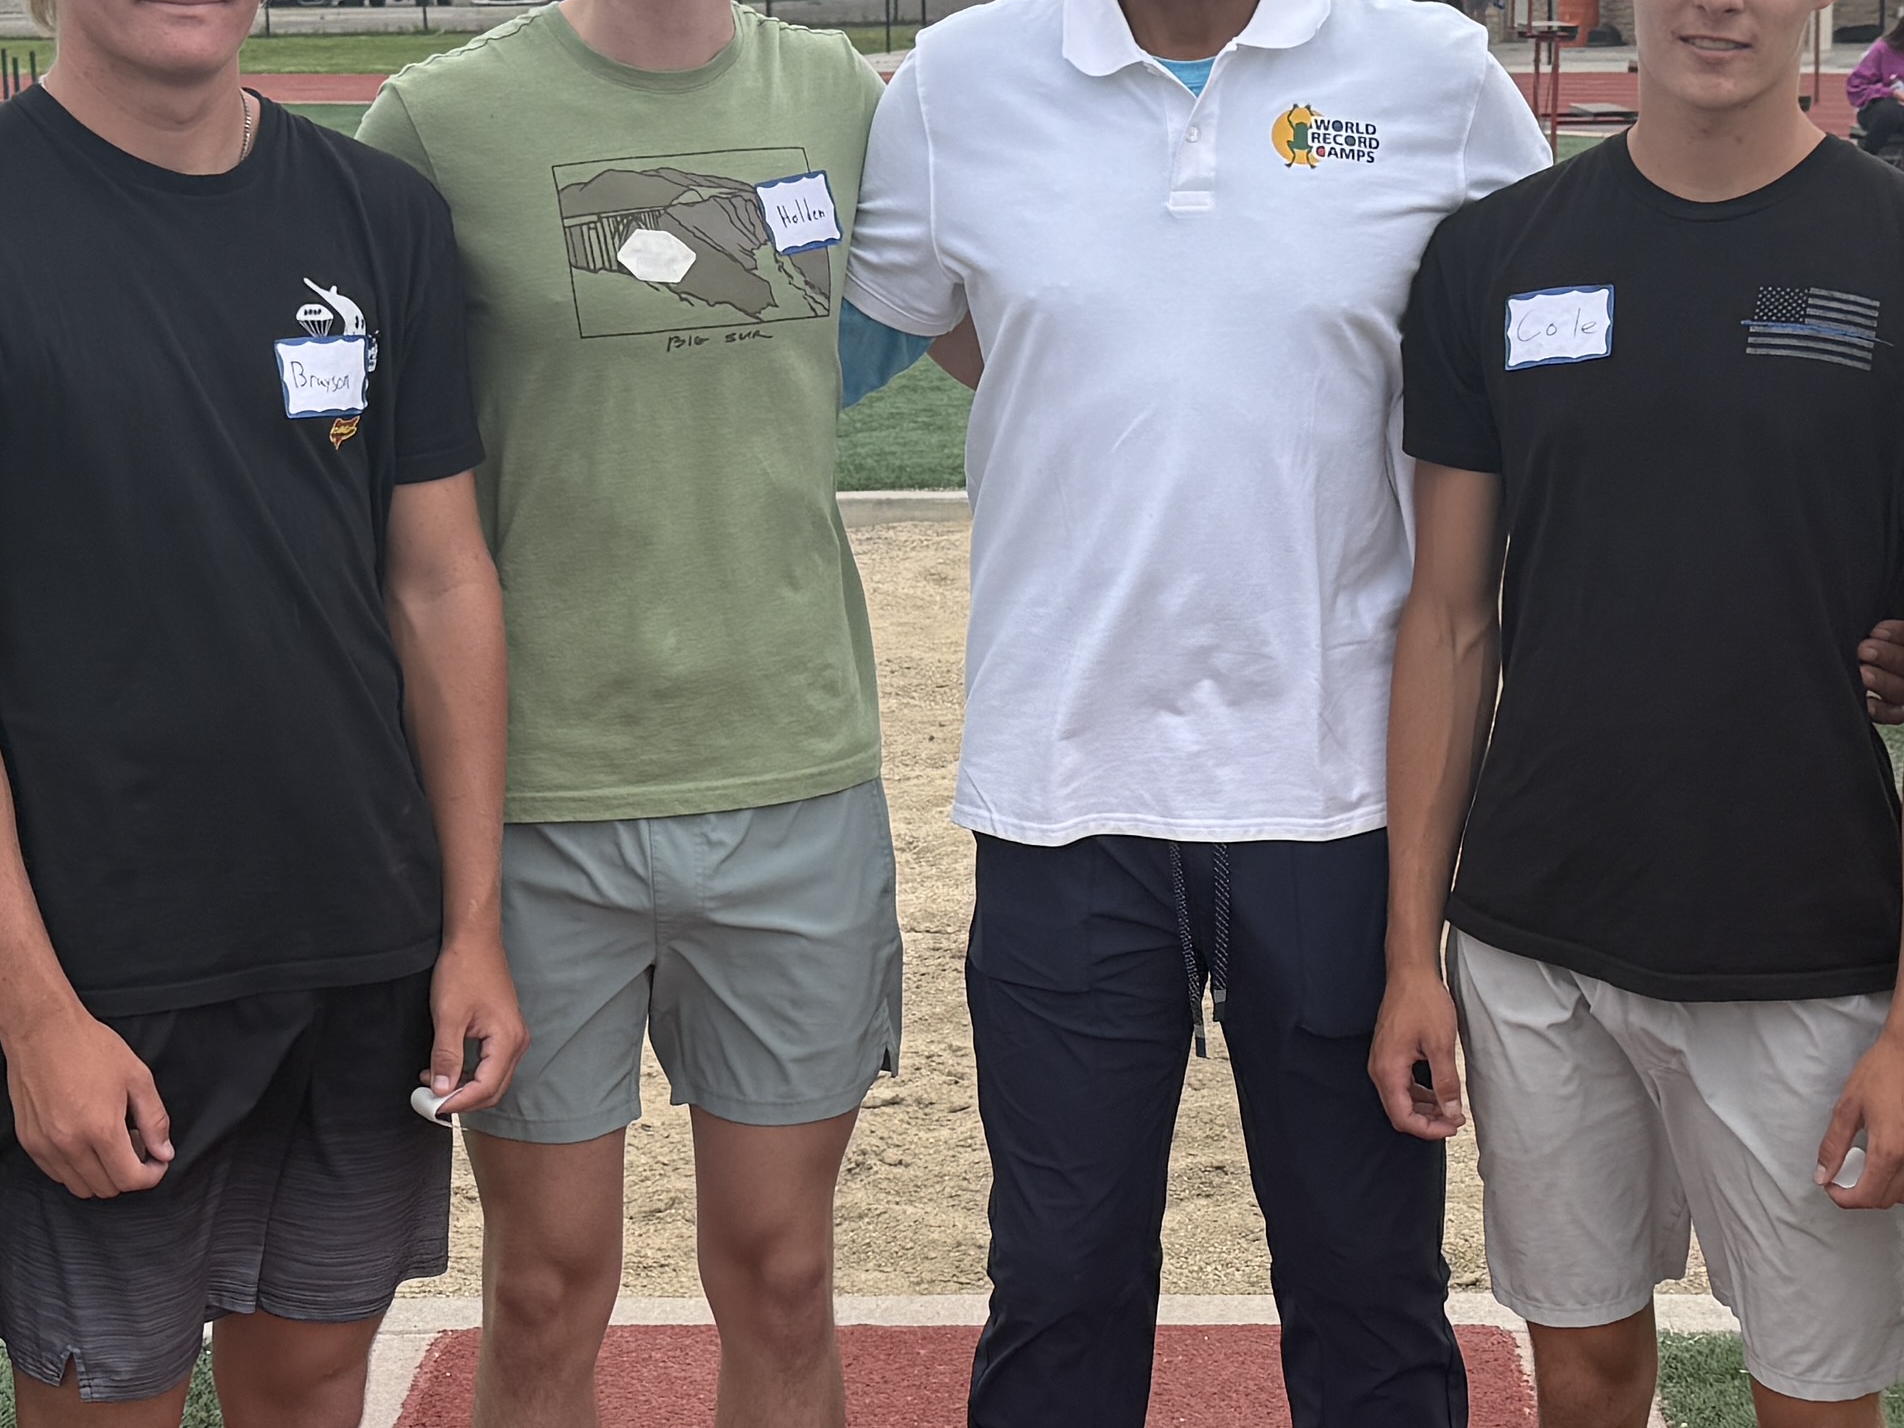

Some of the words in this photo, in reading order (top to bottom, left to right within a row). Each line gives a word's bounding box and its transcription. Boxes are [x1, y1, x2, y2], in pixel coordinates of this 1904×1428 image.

[1313, 118, 1377, 136] WORLD
[1310, 131, 1381, 151] RECORD
[1315, 145, 1376, 164] CAMPS
[776, 197, 826, 229] Holden
[1516, 307, 1598, 342] Cole
[666, 334, 710, 353] BIG
[289, 360, 352, 393] Brayson
